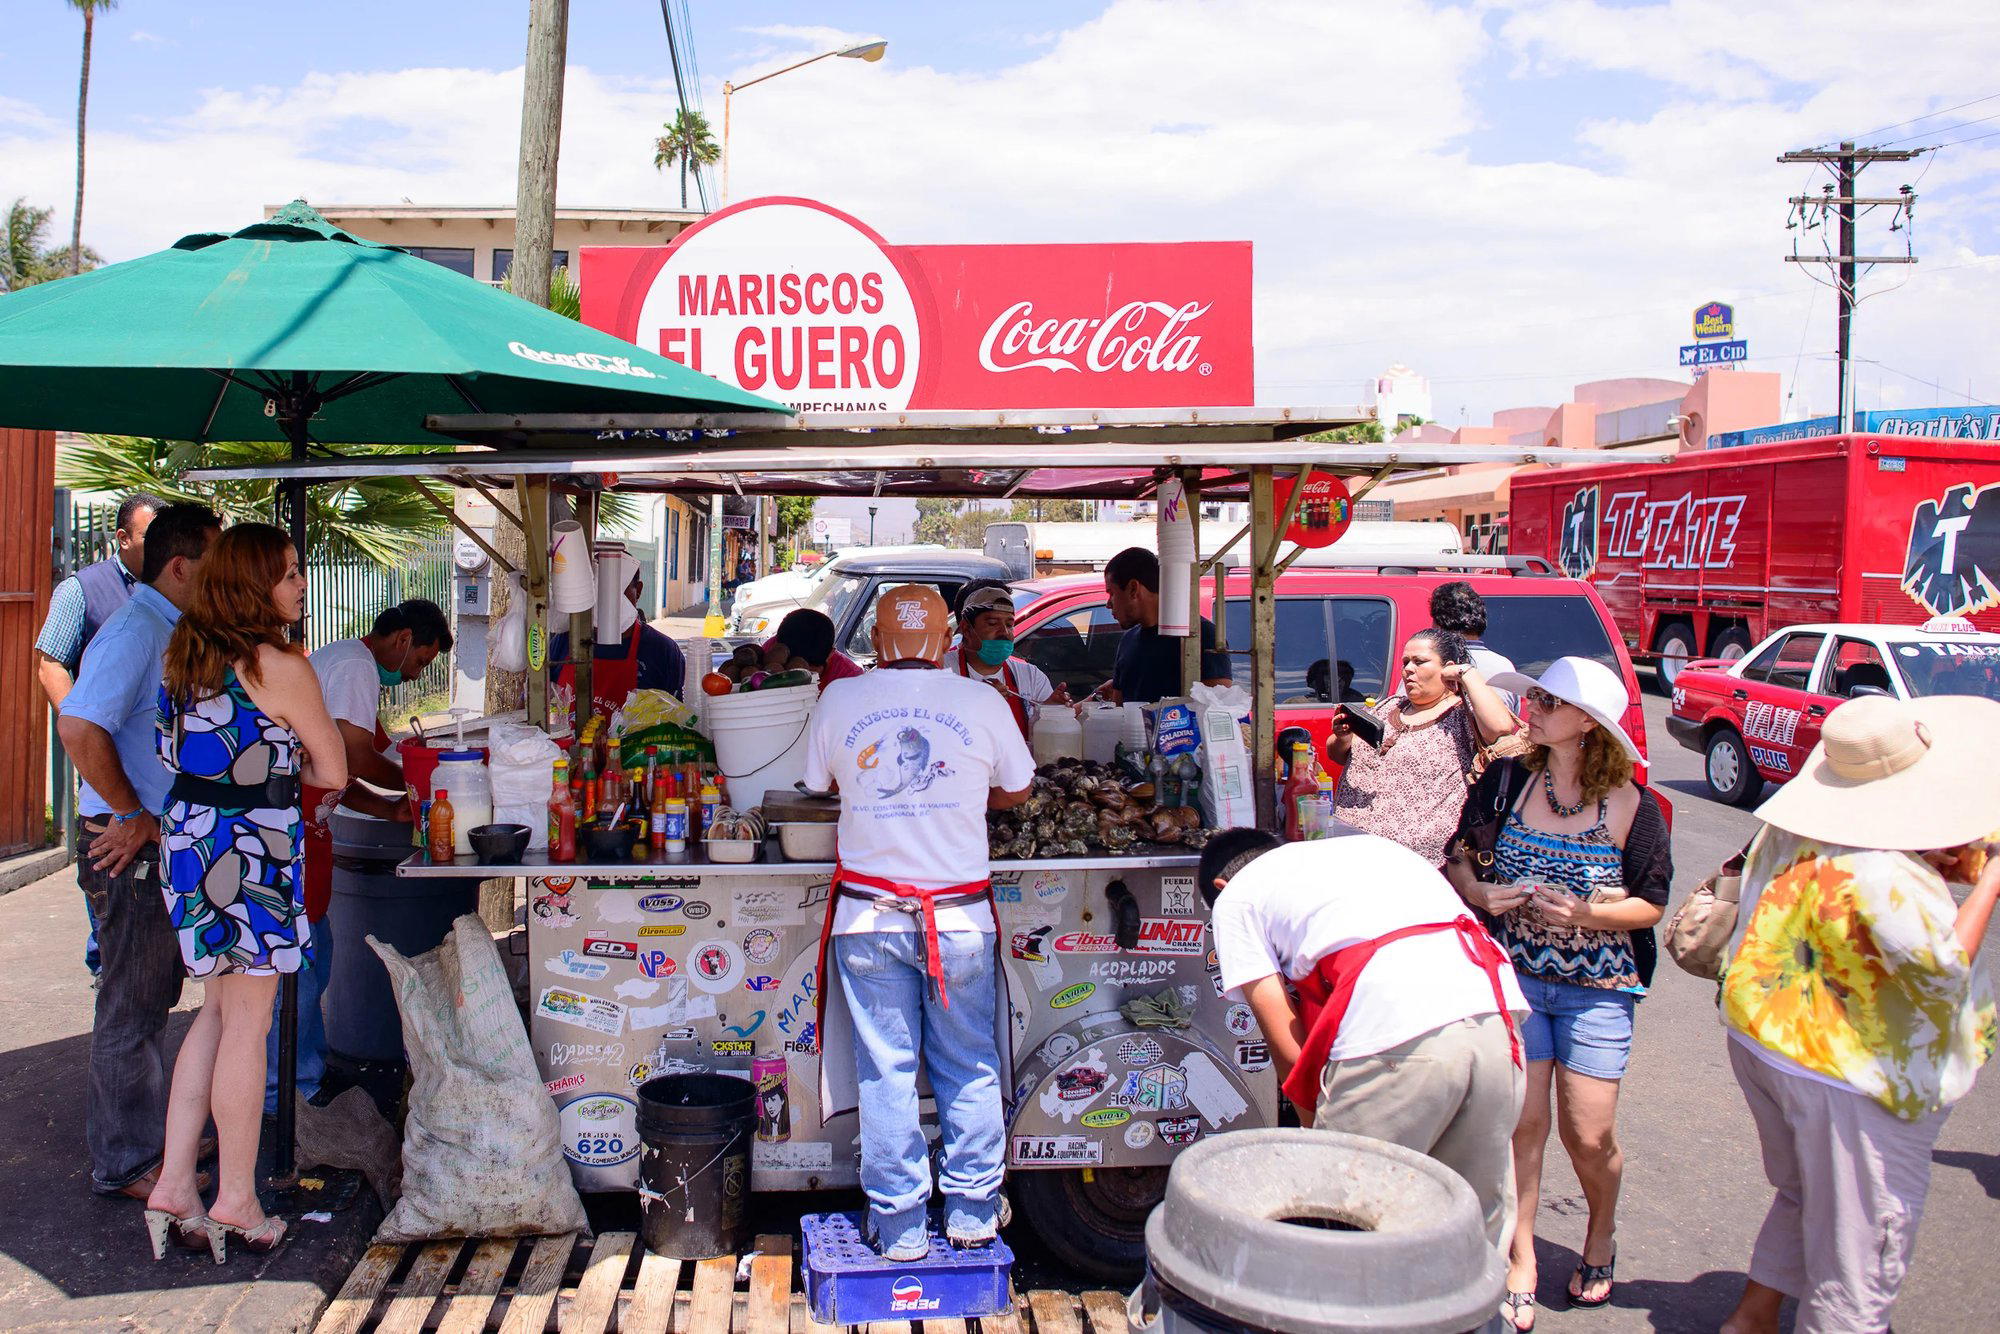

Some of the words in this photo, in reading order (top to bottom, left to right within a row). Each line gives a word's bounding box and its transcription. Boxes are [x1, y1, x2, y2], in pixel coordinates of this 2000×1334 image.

[678, 272, 883, 316] MARISCOS
[1704, 314, 1724, 324] Best
[979, 301, 1214, 373] Coca-Cola
[1696, 323, 1732, 335] Western
[659, 327, 717, 382] EL
[734, 325, 905, 391] GUERO
[1604, 490, 1748, 570] TECATE
[1951, 623, 1975, 632] PLUS
[1919, 642, 1984, 656] TAXI
[845, 708, 909, 749] MARISCOS
[914, 708, 931, 720] EL
[1743, 701, 1802, 746] TAXI
[1159, 729, 1194, 746] SALADITAS
[1751, 746, 1791, 773] PLUS
[746, 929, 771, 942] CHAMUCO
[1055, 931, 1116, 951] Eibac
[588, 941, 627, 953] GD
[640, 950, 666, 978] VP
[1089, 960, 1176, 978] ACOPLADOS
[712, 1041, 752, 1051] OCKSTAR
[549, 1073, 586, 1092] SHARKS
[577, 1139, 623, 1154] 620
[1019, 1142, 1057, 1159] R.J.S.
[1067, 1142, 1088, 1150] RACING
[592, 1156, 619, 1164] COMERCIO
[890, 1298, 941, 1312] PEPSI
